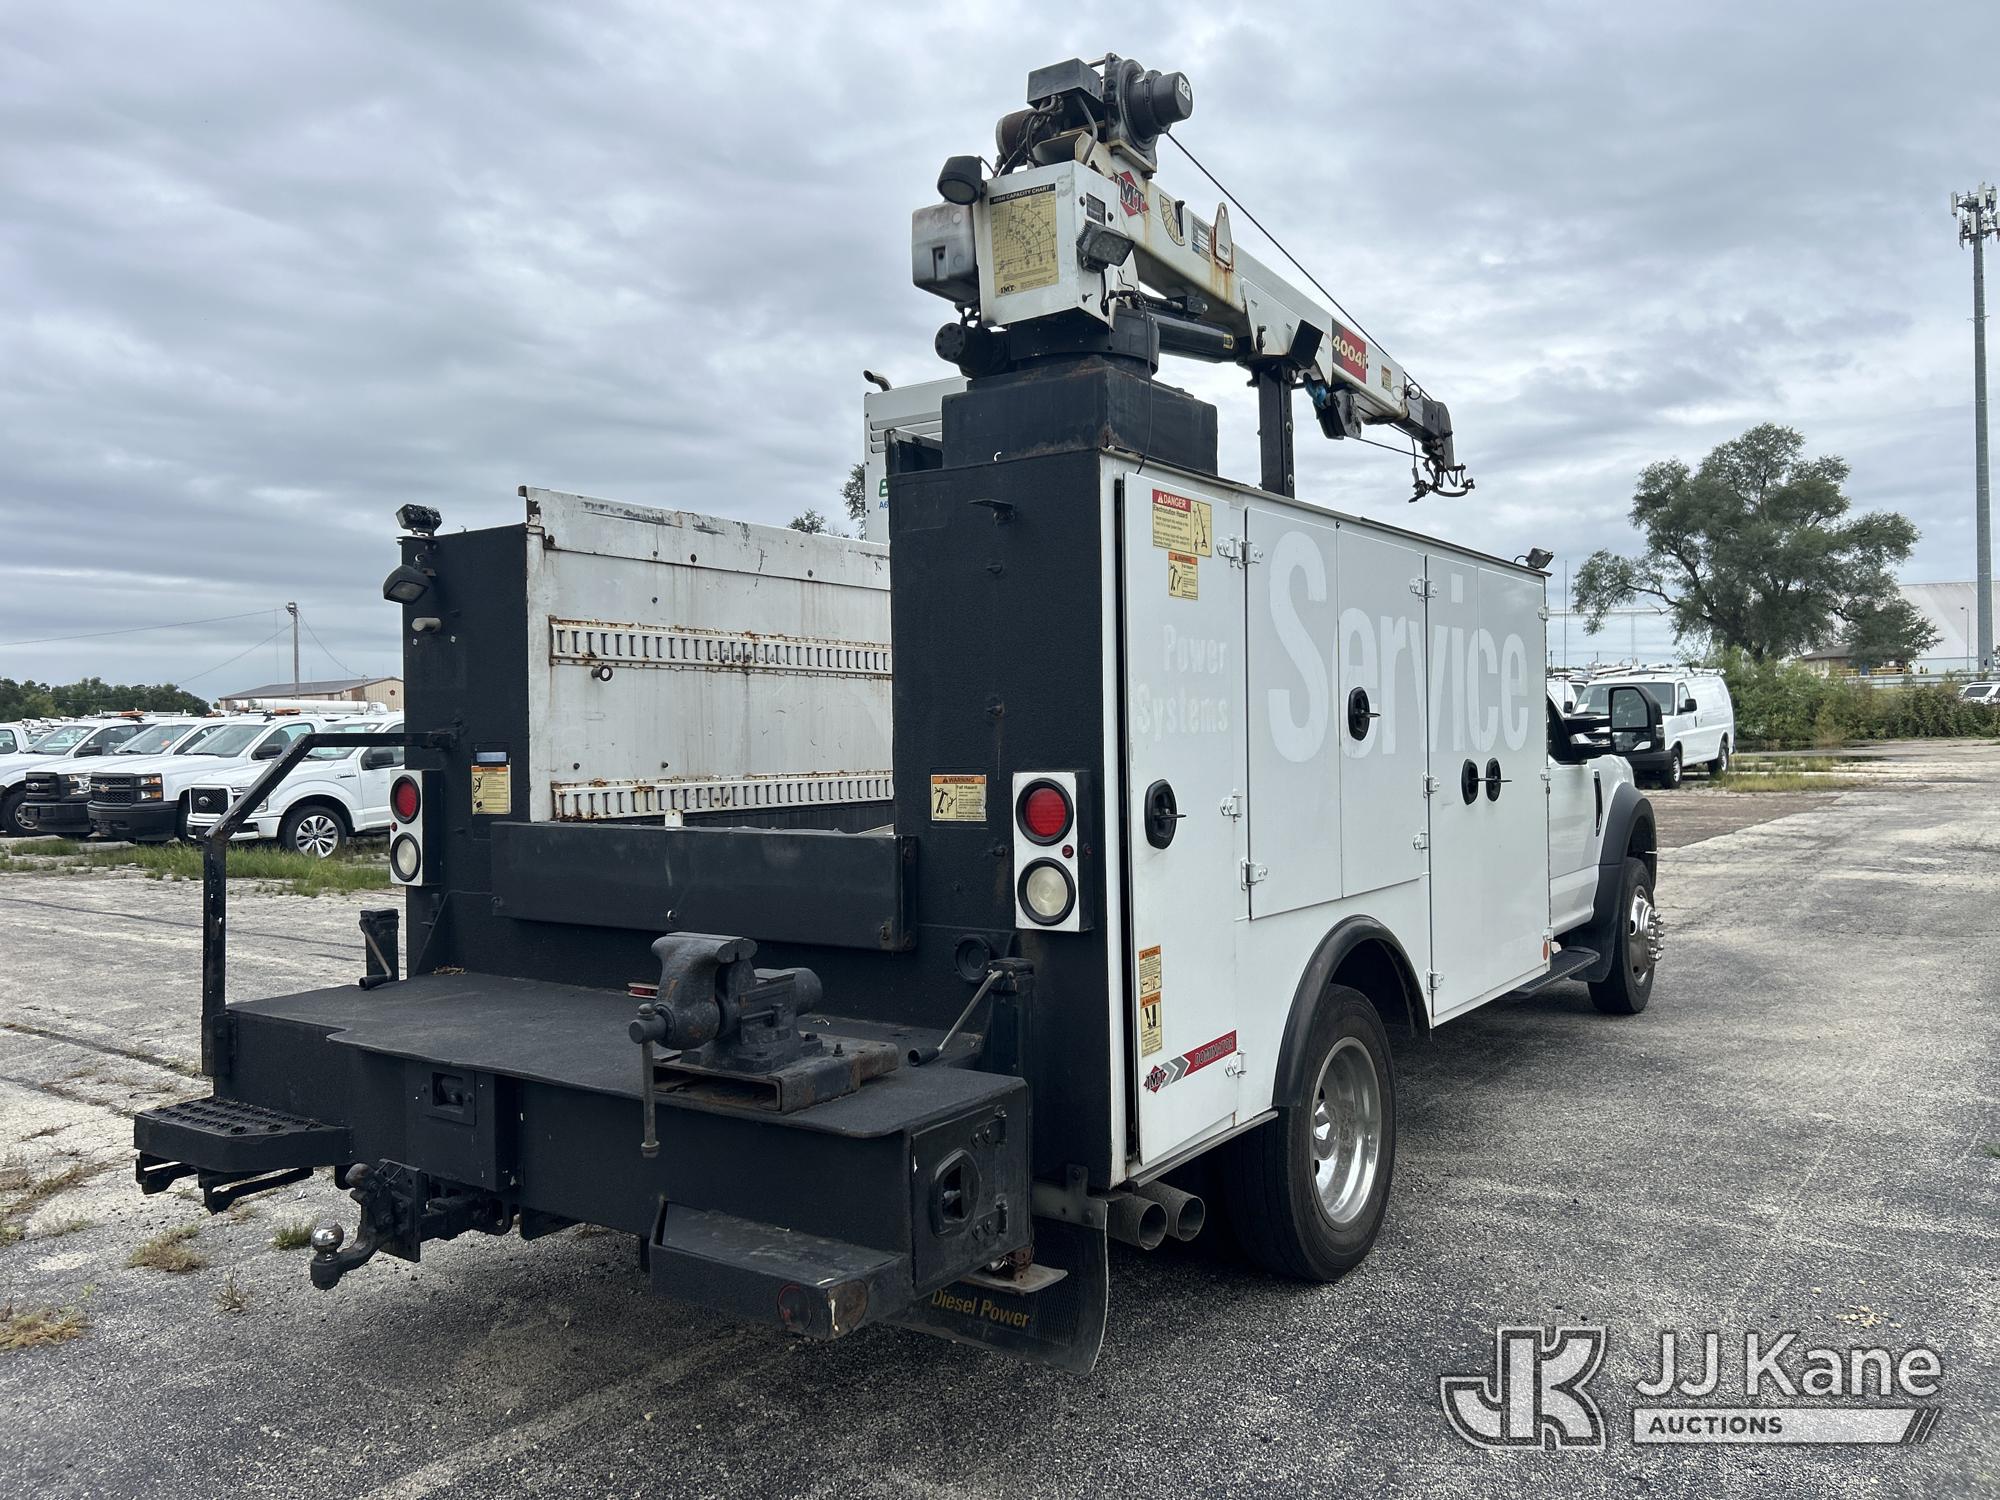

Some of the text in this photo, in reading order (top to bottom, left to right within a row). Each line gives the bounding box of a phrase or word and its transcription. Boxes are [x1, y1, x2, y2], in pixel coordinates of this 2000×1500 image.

[1112, 171, 1146, 214] IMT
[1000, 284, 1015, 294] IMT
[1332, 335, 1366, 369] 4004i
[1164, 494, 1187, 509] DANGER
[1163, 624, 1227, 674] Power
[1268, 531, 1529, 762] Service
[1136, 683, 1229, 742] Systems
[1194, 1036, 1233, 1067] DOMINATOR
[931, 1288, 1031, 1328] Diesel Power
